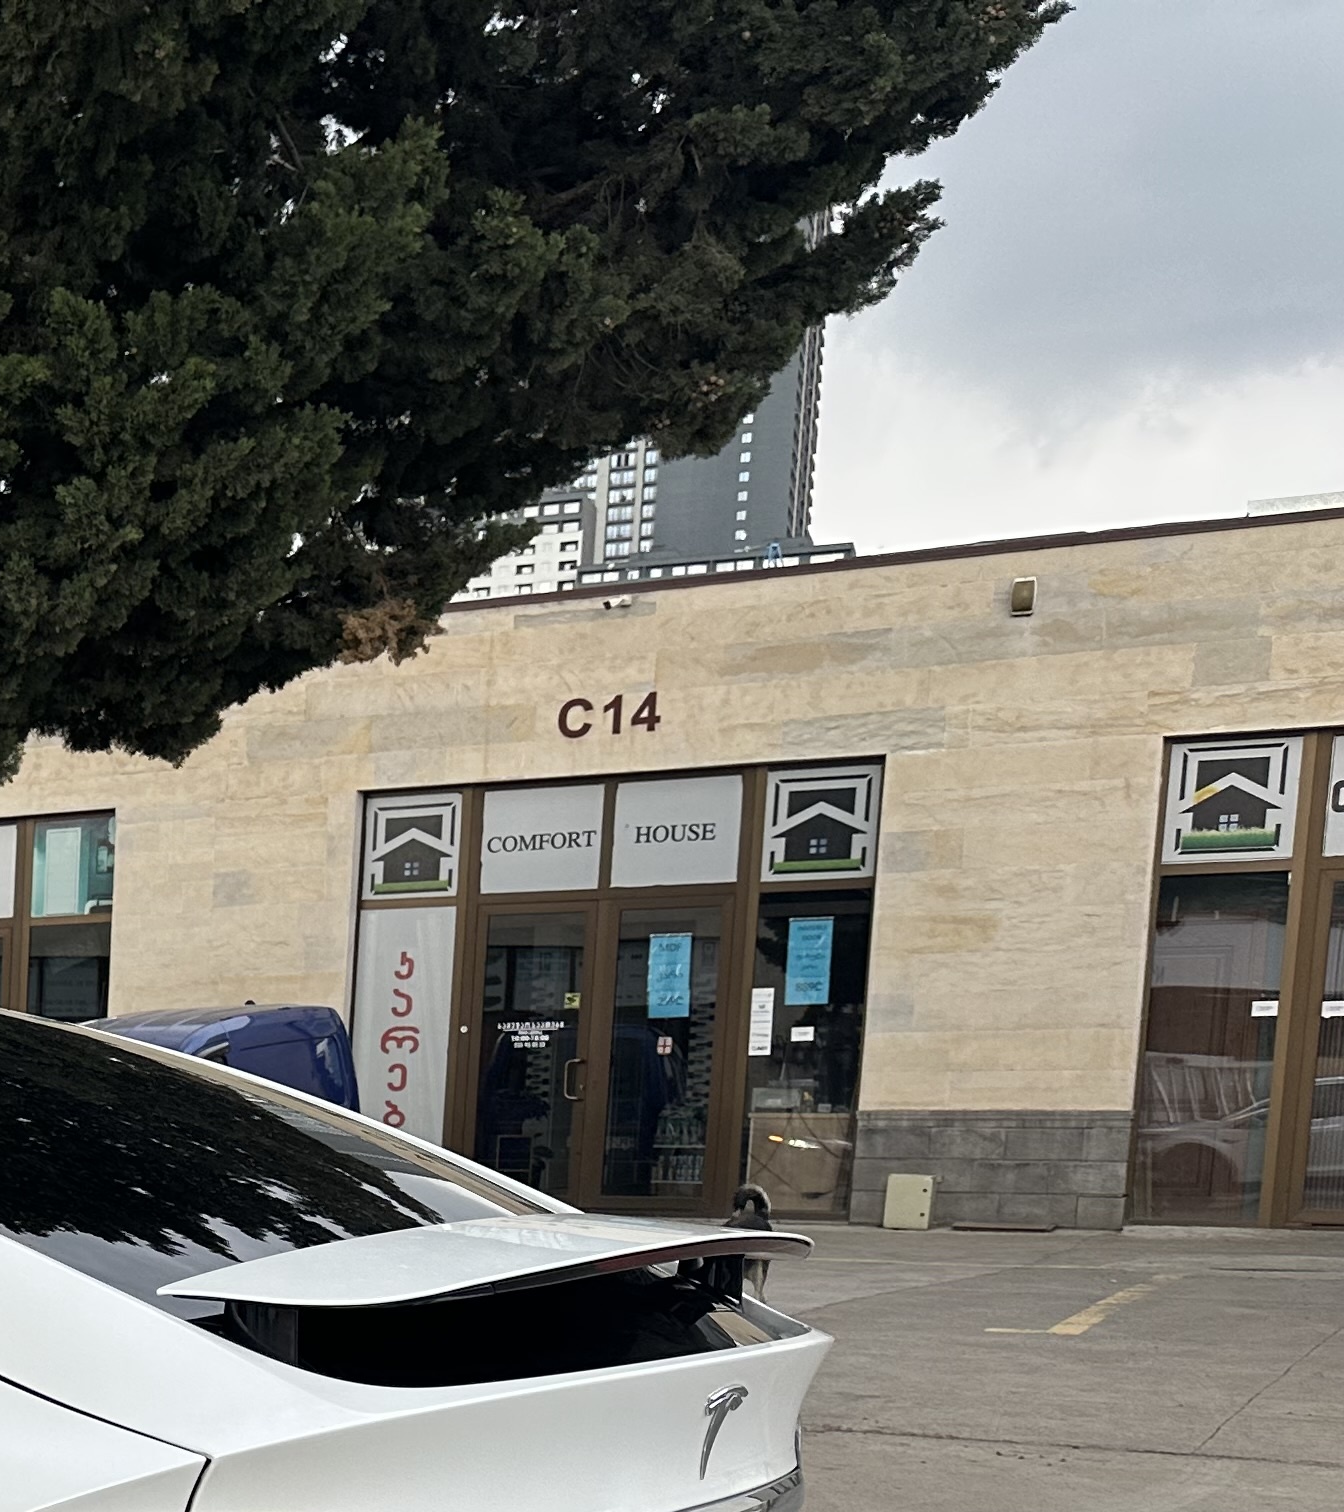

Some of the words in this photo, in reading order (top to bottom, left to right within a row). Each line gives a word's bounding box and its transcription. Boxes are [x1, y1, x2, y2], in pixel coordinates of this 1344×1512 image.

[557, 691, 661, 738] C14
[487, 830, 597, 853] COMFORT
[634, 823, 716, 844] HOUSE
